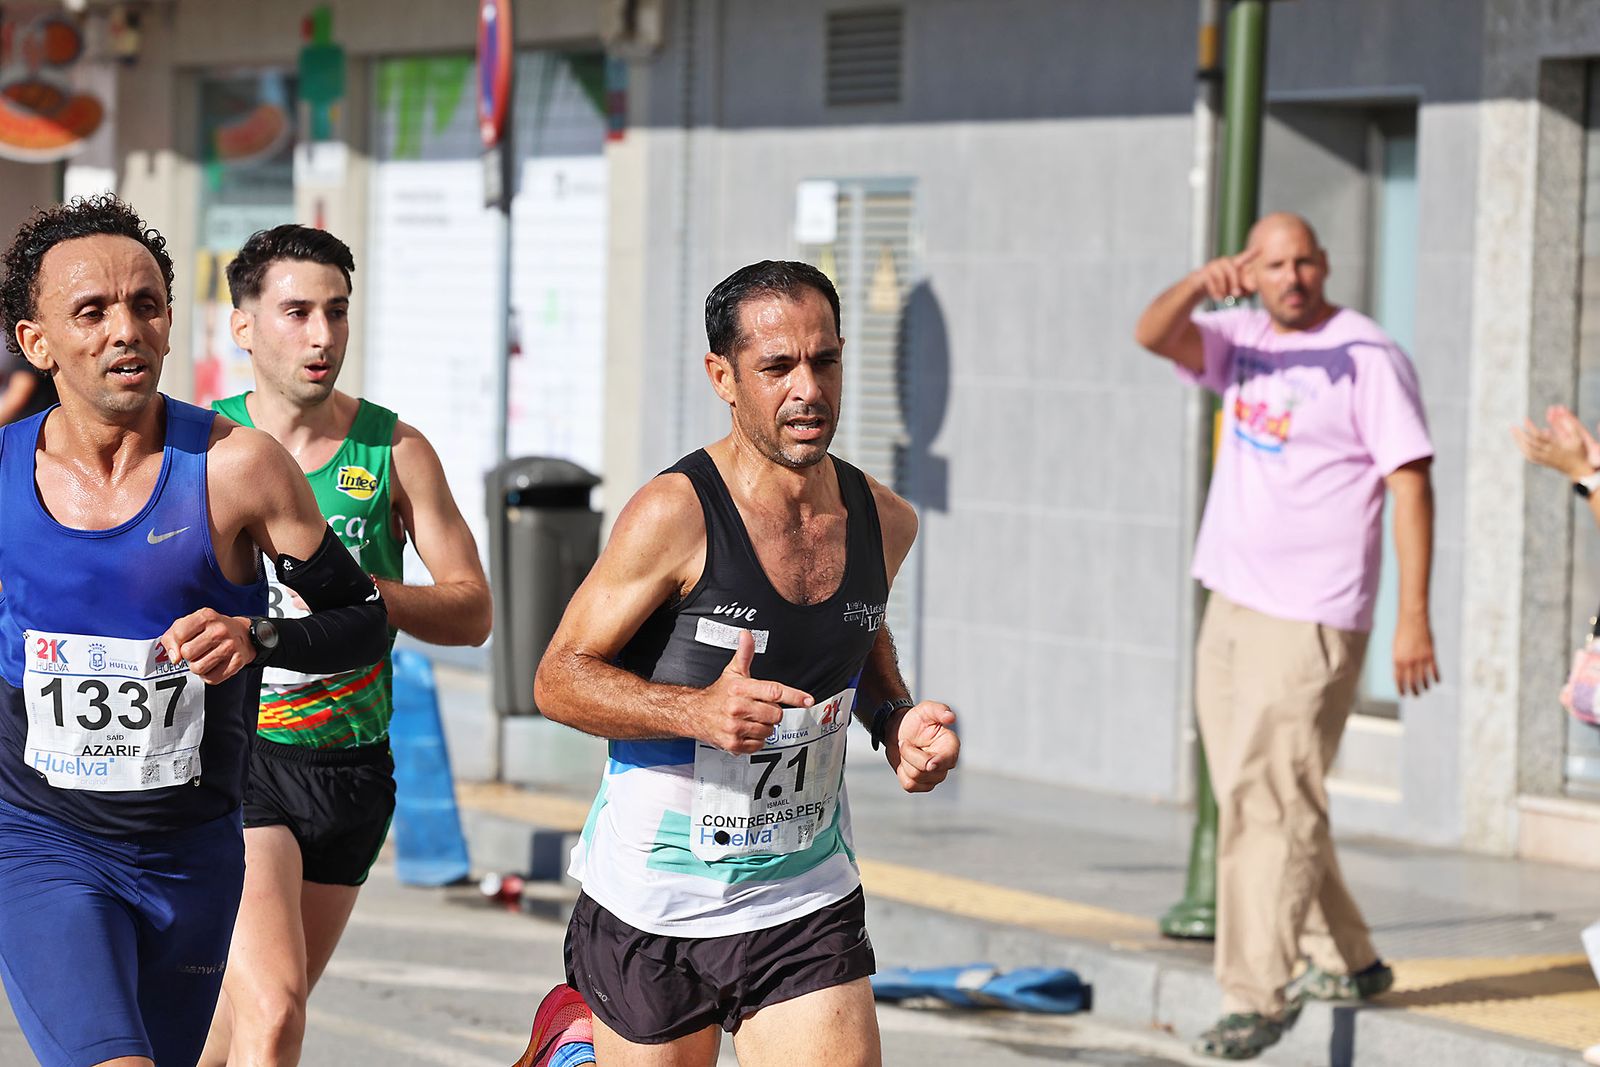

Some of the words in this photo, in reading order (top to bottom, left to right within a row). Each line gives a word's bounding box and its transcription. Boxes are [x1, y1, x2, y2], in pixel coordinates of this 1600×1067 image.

[36, 638, 68, 664] 21K
[36, 660, 70, 673] HUELVA
[109, 662, 139, 672] HUELVA
[40, 676, 188, 731] 1337
[782, 730, 808, 740] HUELVA
[81, 744, 141, 757] AZARIF
[34, 752, 108, 777] Huelva
[767, 798, 789, 808] ISMAEL
[702, 808, 793, 828] CONTRERAS
[796, 802, 822, 816] PER
